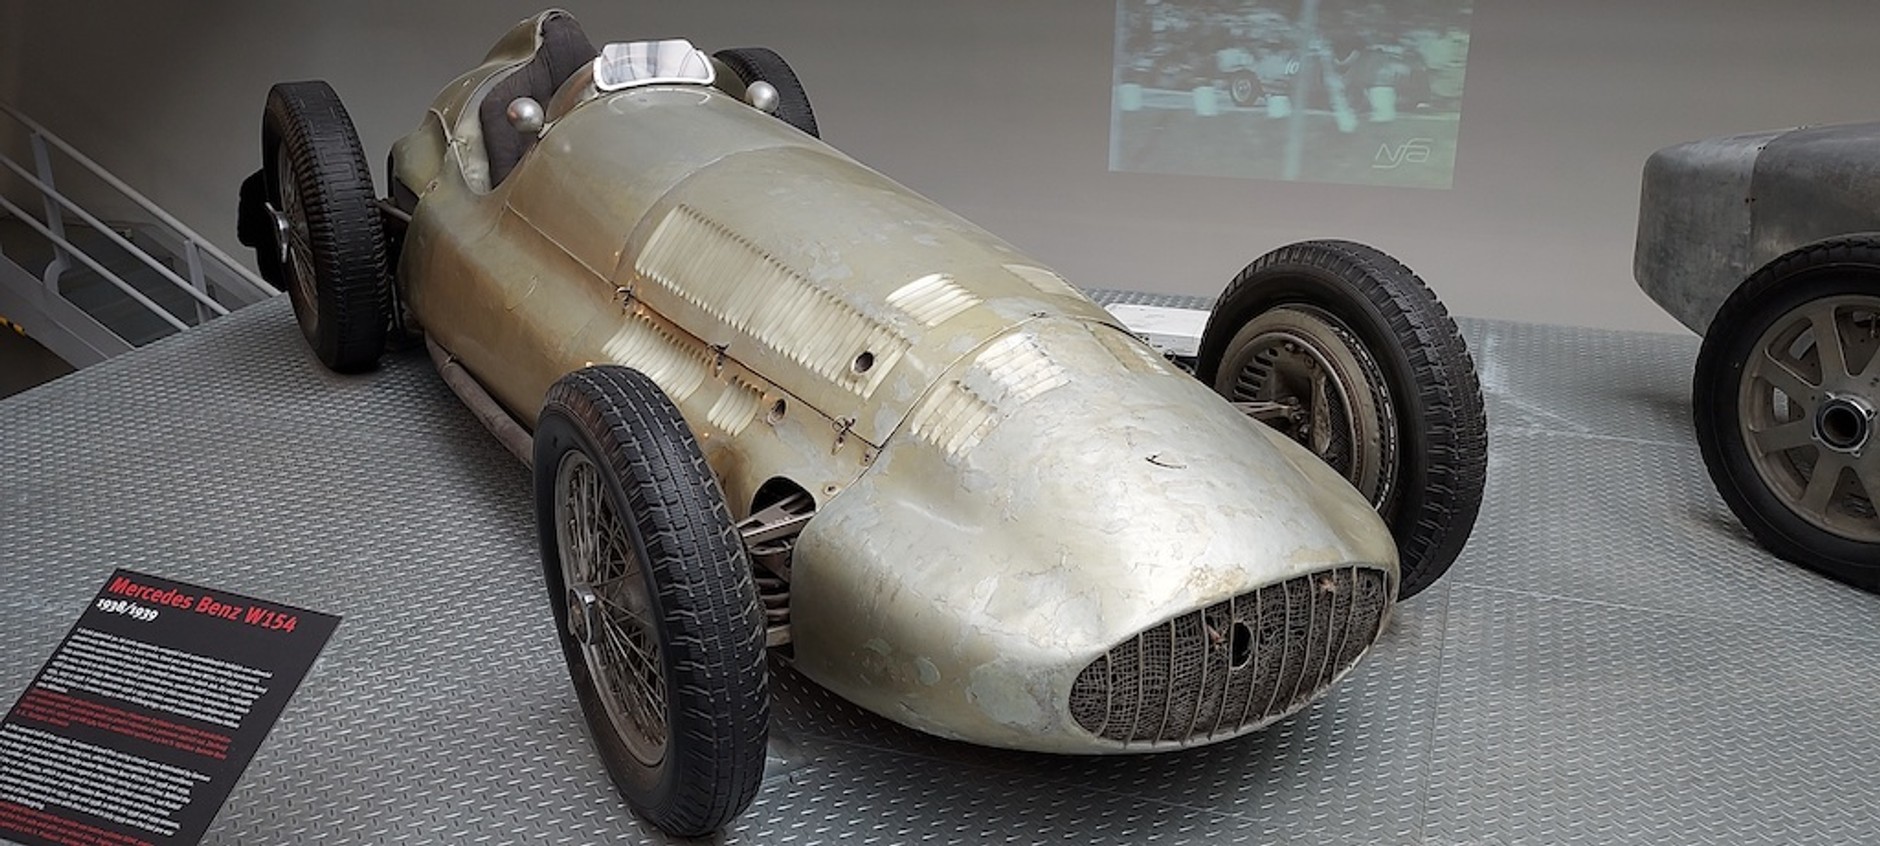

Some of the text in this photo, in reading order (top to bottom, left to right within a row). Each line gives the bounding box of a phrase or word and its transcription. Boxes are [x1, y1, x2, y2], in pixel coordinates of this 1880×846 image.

[96, 598, 159, 621] 1938/1939
[109, 577, 298, 632] Mercedes Benz W154
